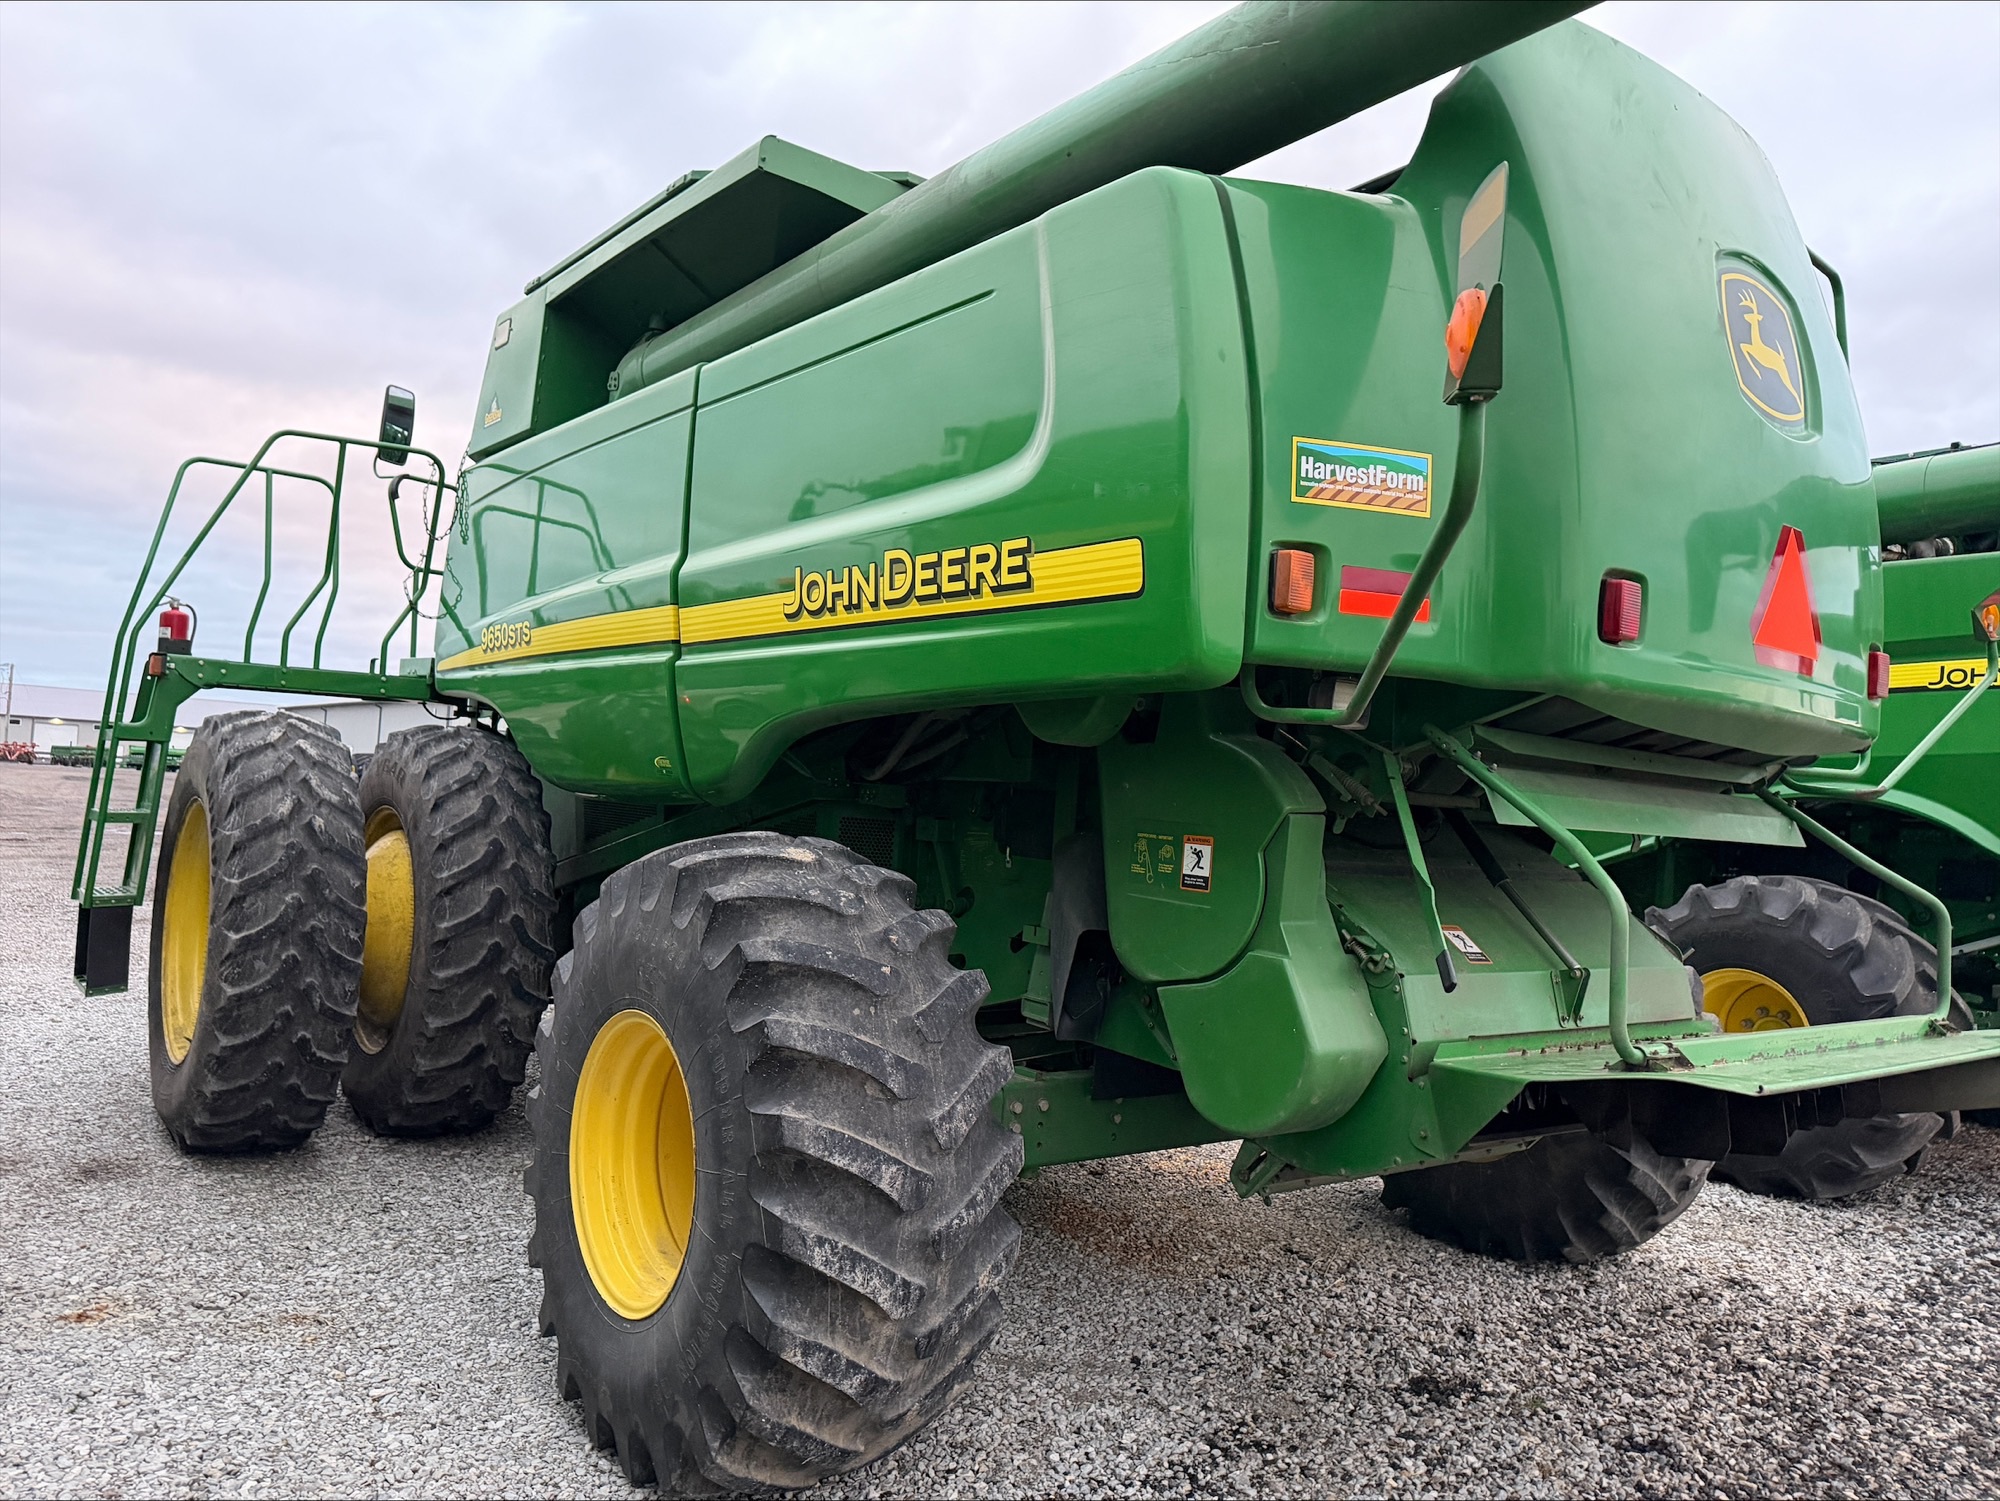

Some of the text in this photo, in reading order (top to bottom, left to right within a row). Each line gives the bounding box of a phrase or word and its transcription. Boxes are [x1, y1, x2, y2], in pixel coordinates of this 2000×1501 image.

[1300, 455, 1424, 492] HarvestForm
[783, 536, 1034, 622] JOHN DEERE
[481, 621, 532, 654] 9650STS
[1928, 665, 2000, 686] JOH
